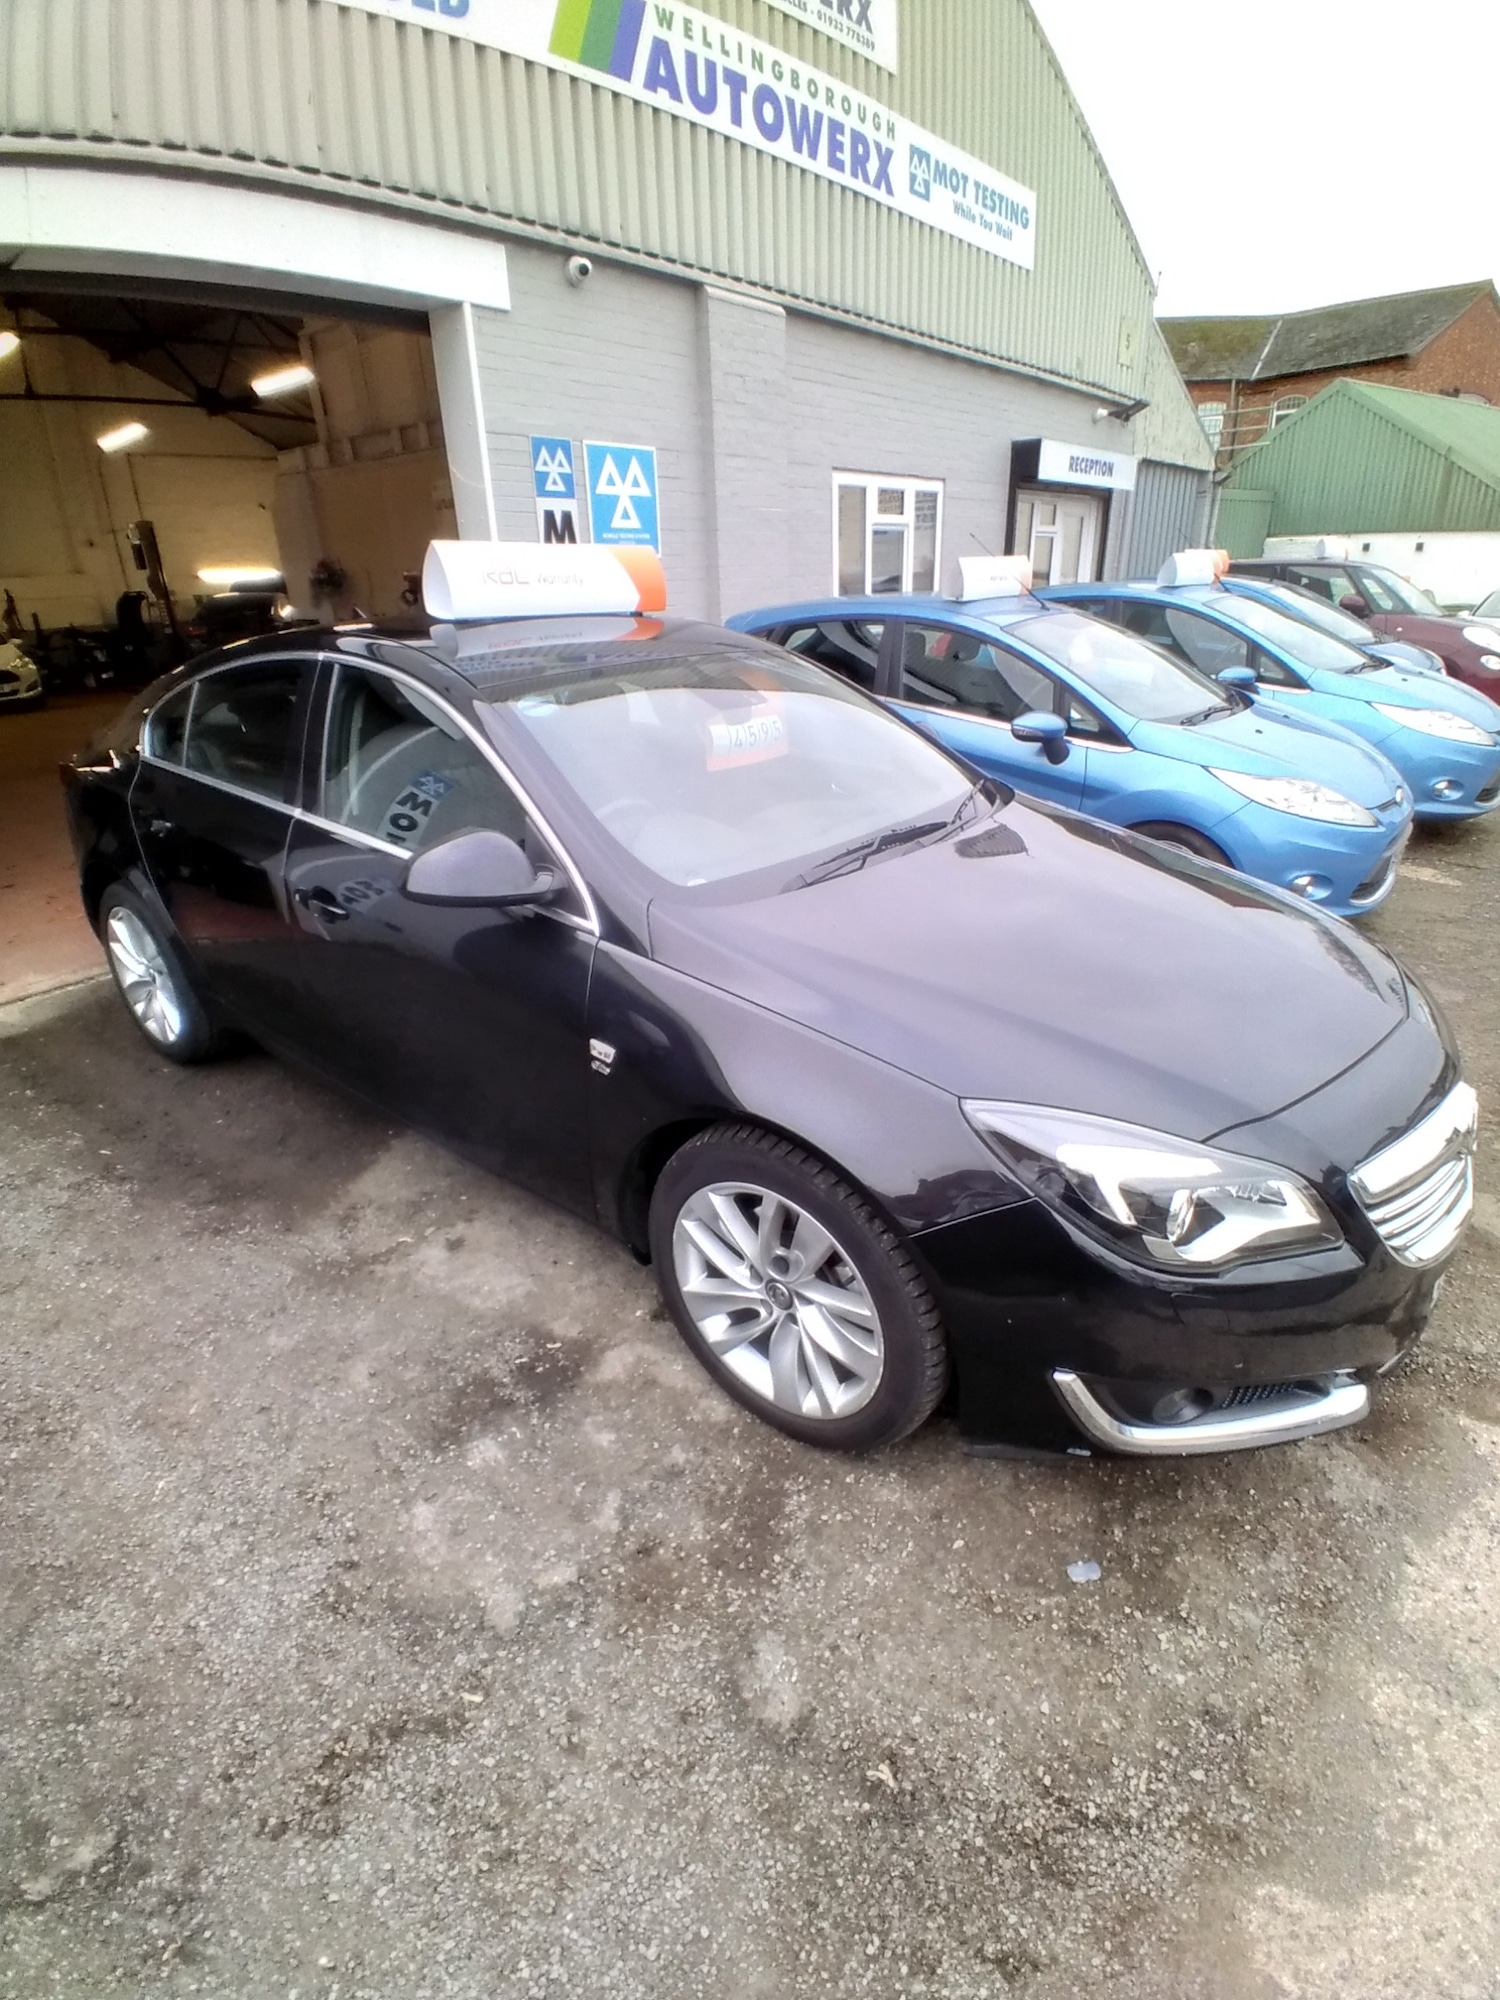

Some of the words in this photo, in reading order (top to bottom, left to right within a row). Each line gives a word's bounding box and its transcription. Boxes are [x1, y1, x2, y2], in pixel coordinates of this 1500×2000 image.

[653, 3, 896, 141] WELLINGBOROUGH
[643, 35, 895, 198] AUTOWERX
[932, 158, 969, 199] MOT
[973, 178, 1030, 230] TESTING
[952, 199, 977, 224] While
[979, 212, 1003, 233] You
[995, 221, 1013, 241] Wait
[1068, 455, 1115, 478] RECEPTION
